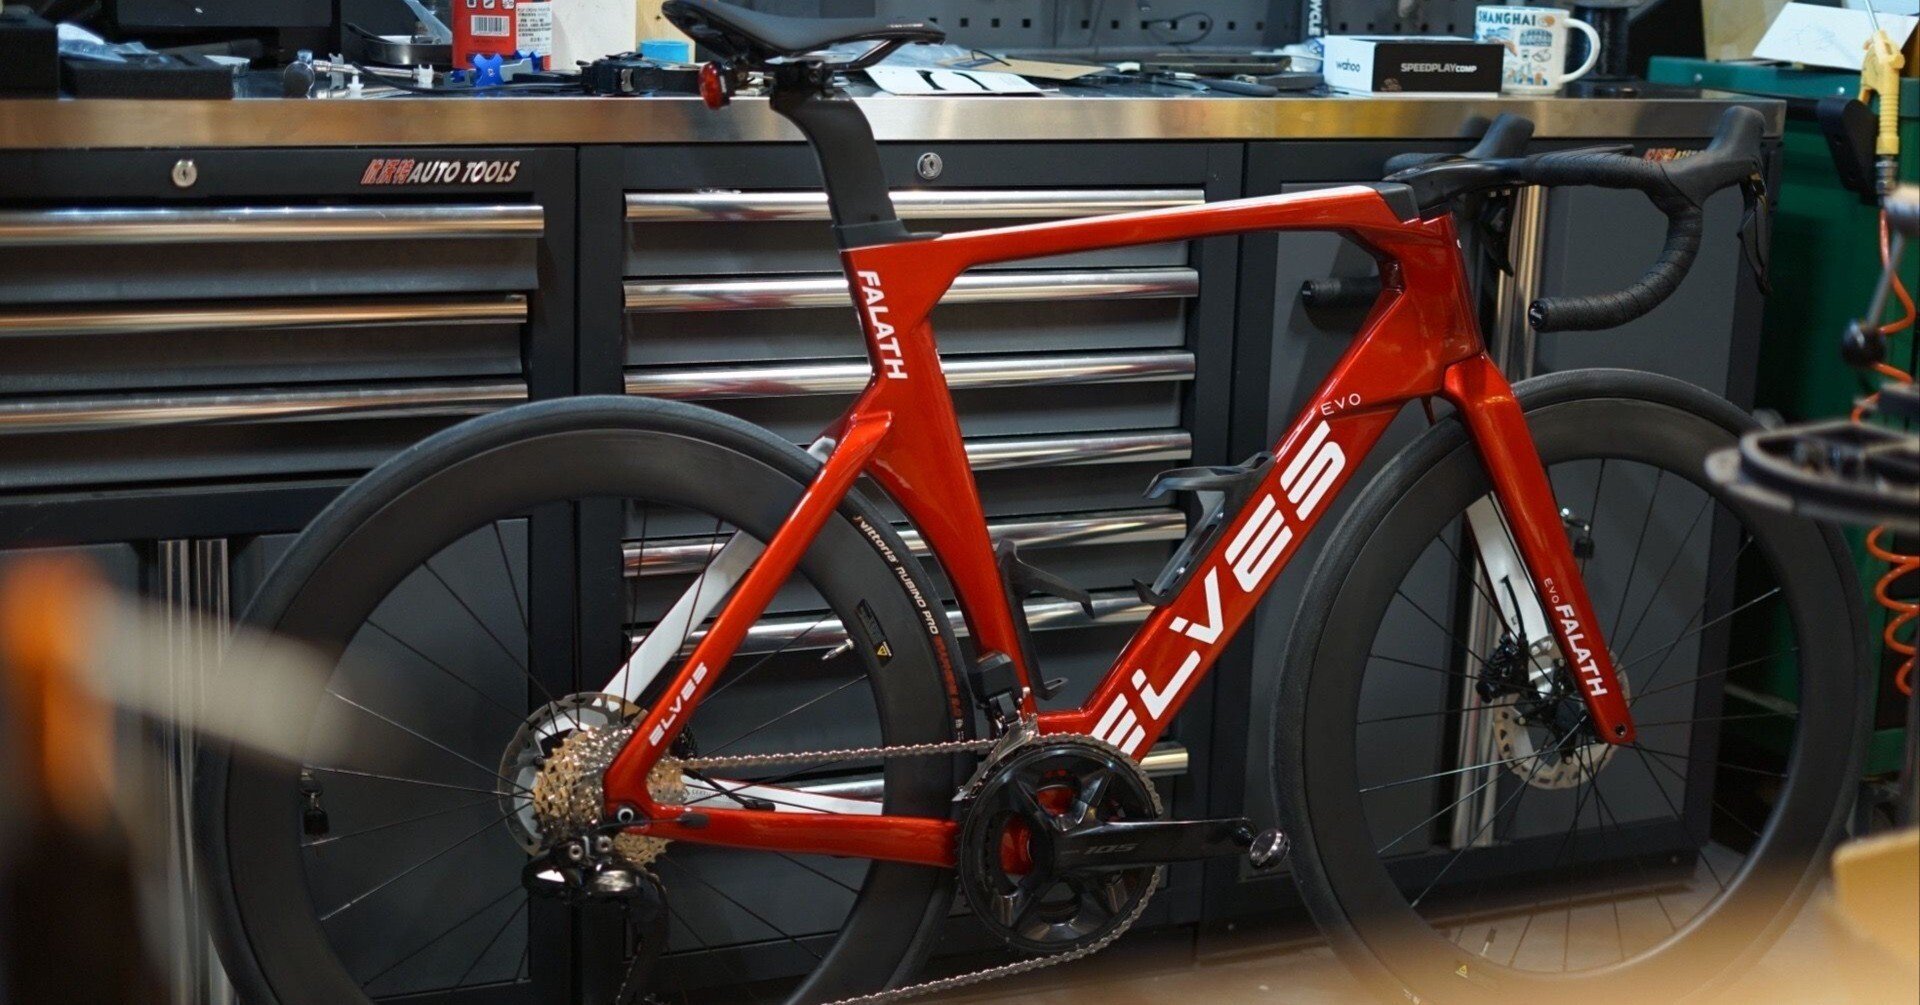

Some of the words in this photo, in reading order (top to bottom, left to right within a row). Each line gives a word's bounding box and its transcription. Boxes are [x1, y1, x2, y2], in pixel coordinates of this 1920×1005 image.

[1478, 10, 1536, 26] SHANGHAI
[1336, 58, 1361, 72] wahoo
[406, 161, 461, 183] AUTO
[461, 161, 521, 183] TOOLS
[857, 270, 909, 379] FALATH
[1321, 393, 1361, 416] EVO
[860, 520, 899, 564] vittoria
[896, 566, 927, 608] RUBINO
[922, 610, 939, 635] PRO
[1090, 420, 1347, 756] ELVES
[1543, 577, 1560, 604] EVO
[1554, 604, 1609, 697] FALATH
[649, 662, 708, 746] ELVES
[1084, 843, 1139, 855] 105
